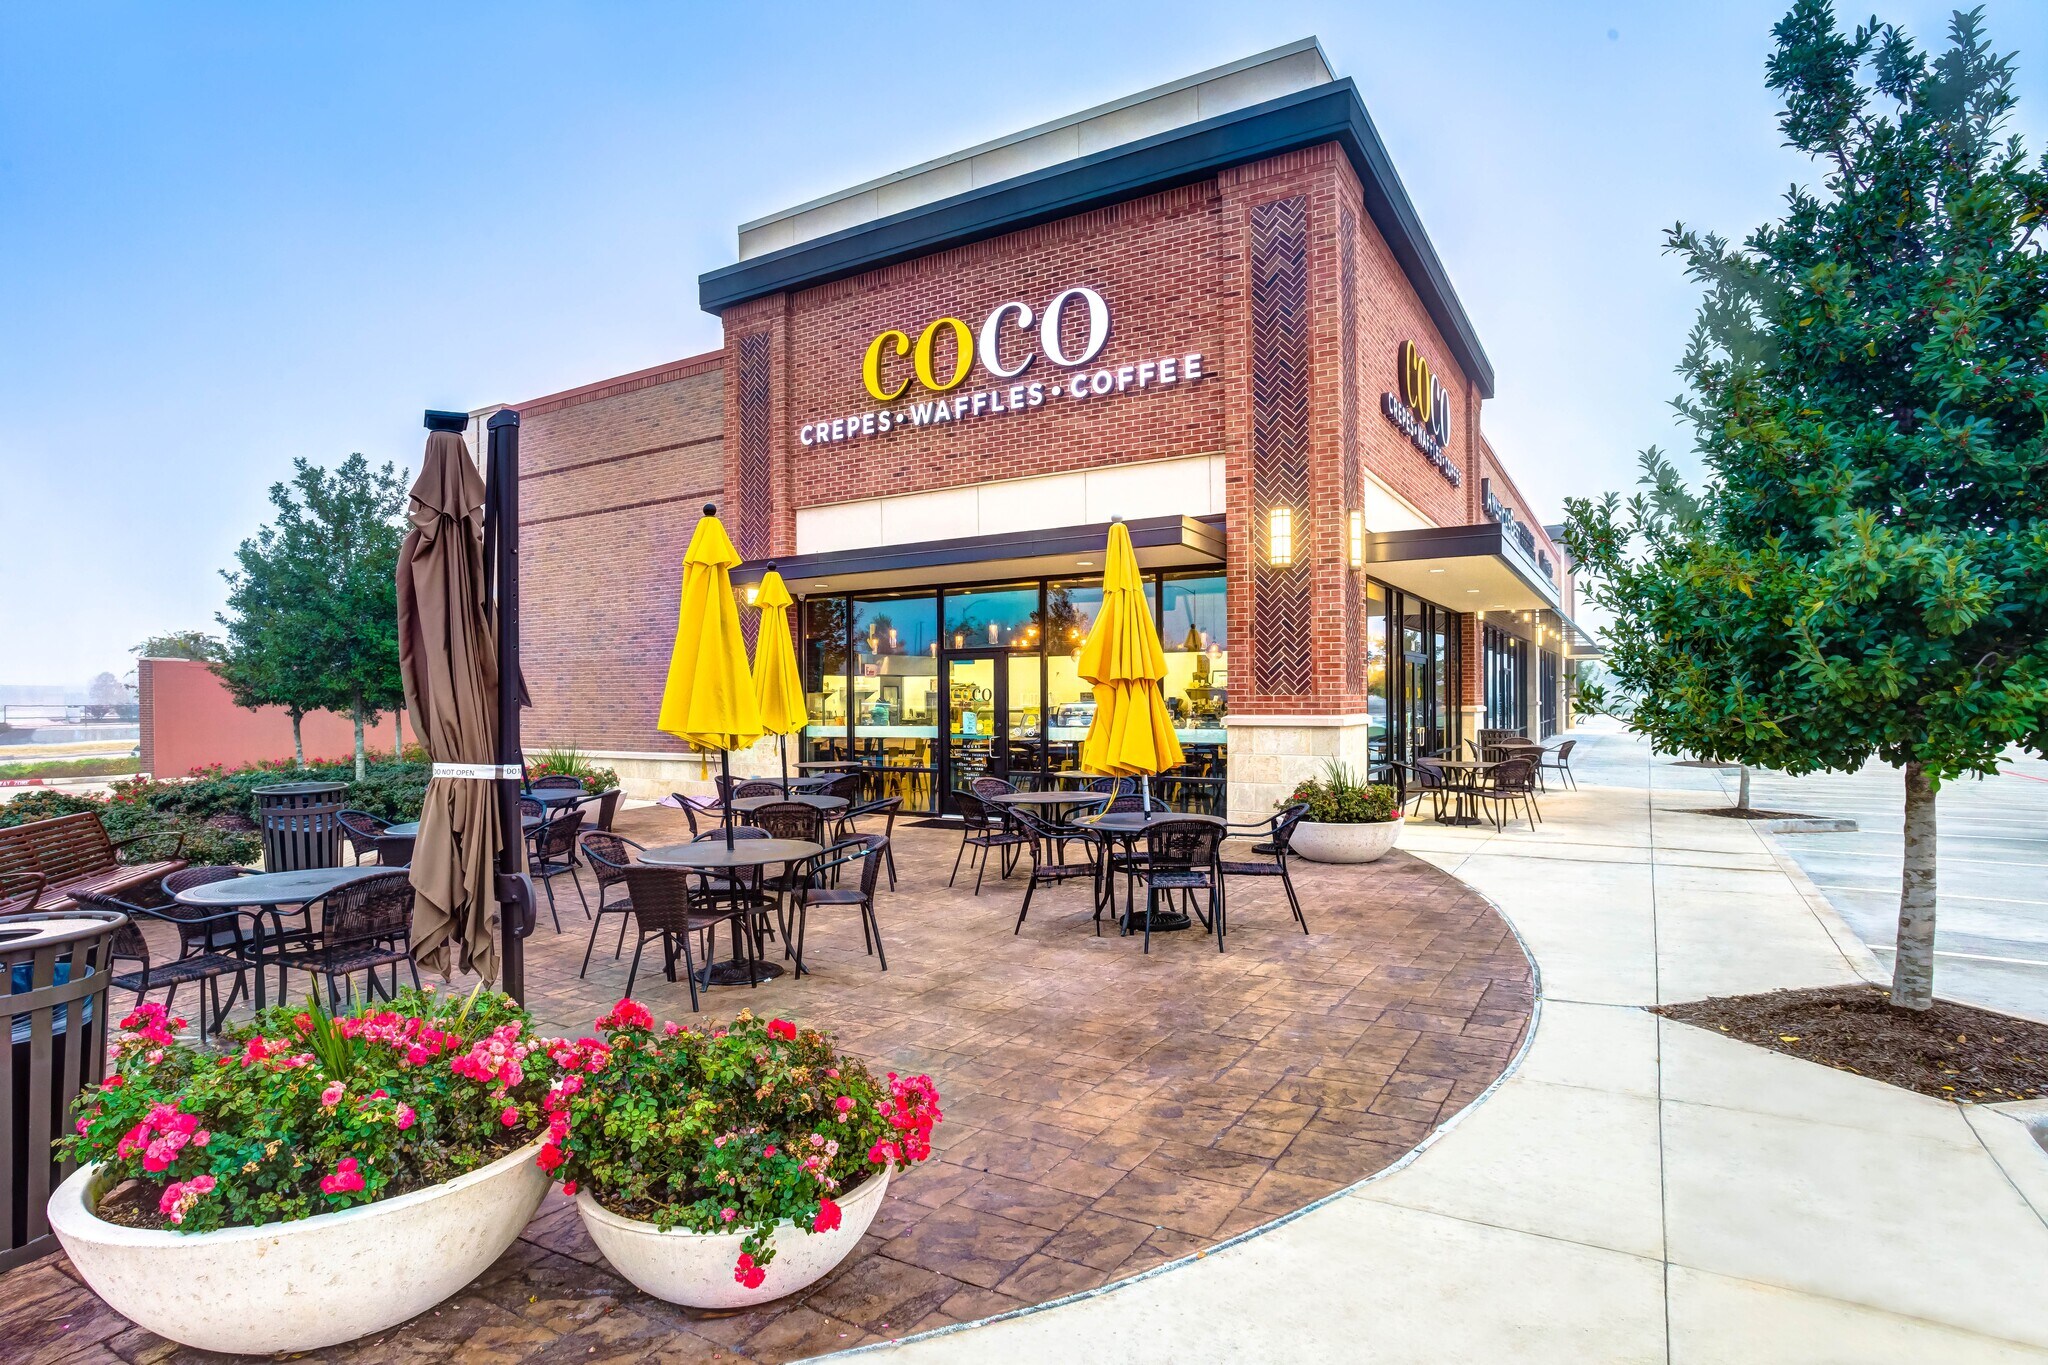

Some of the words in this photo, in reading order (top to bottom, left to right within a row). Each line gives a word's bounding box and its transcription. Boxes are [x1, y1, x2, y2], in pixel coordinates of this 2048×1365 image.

[862, 286, 1113, 402] COCO
[800, 409, 893, 447] CREPES
[910, 382, 1046, 428] WAFFLES
[1069, 353, 1204, 400] COFFEE
[1388, 391, 1414, 437] CREPES
[1404, 339, 1451, 448] COCO
[442, 768, 454, 776] NOT
[456, 769, 475, 777] OPEN
[506, 767, 517, 775] DO
